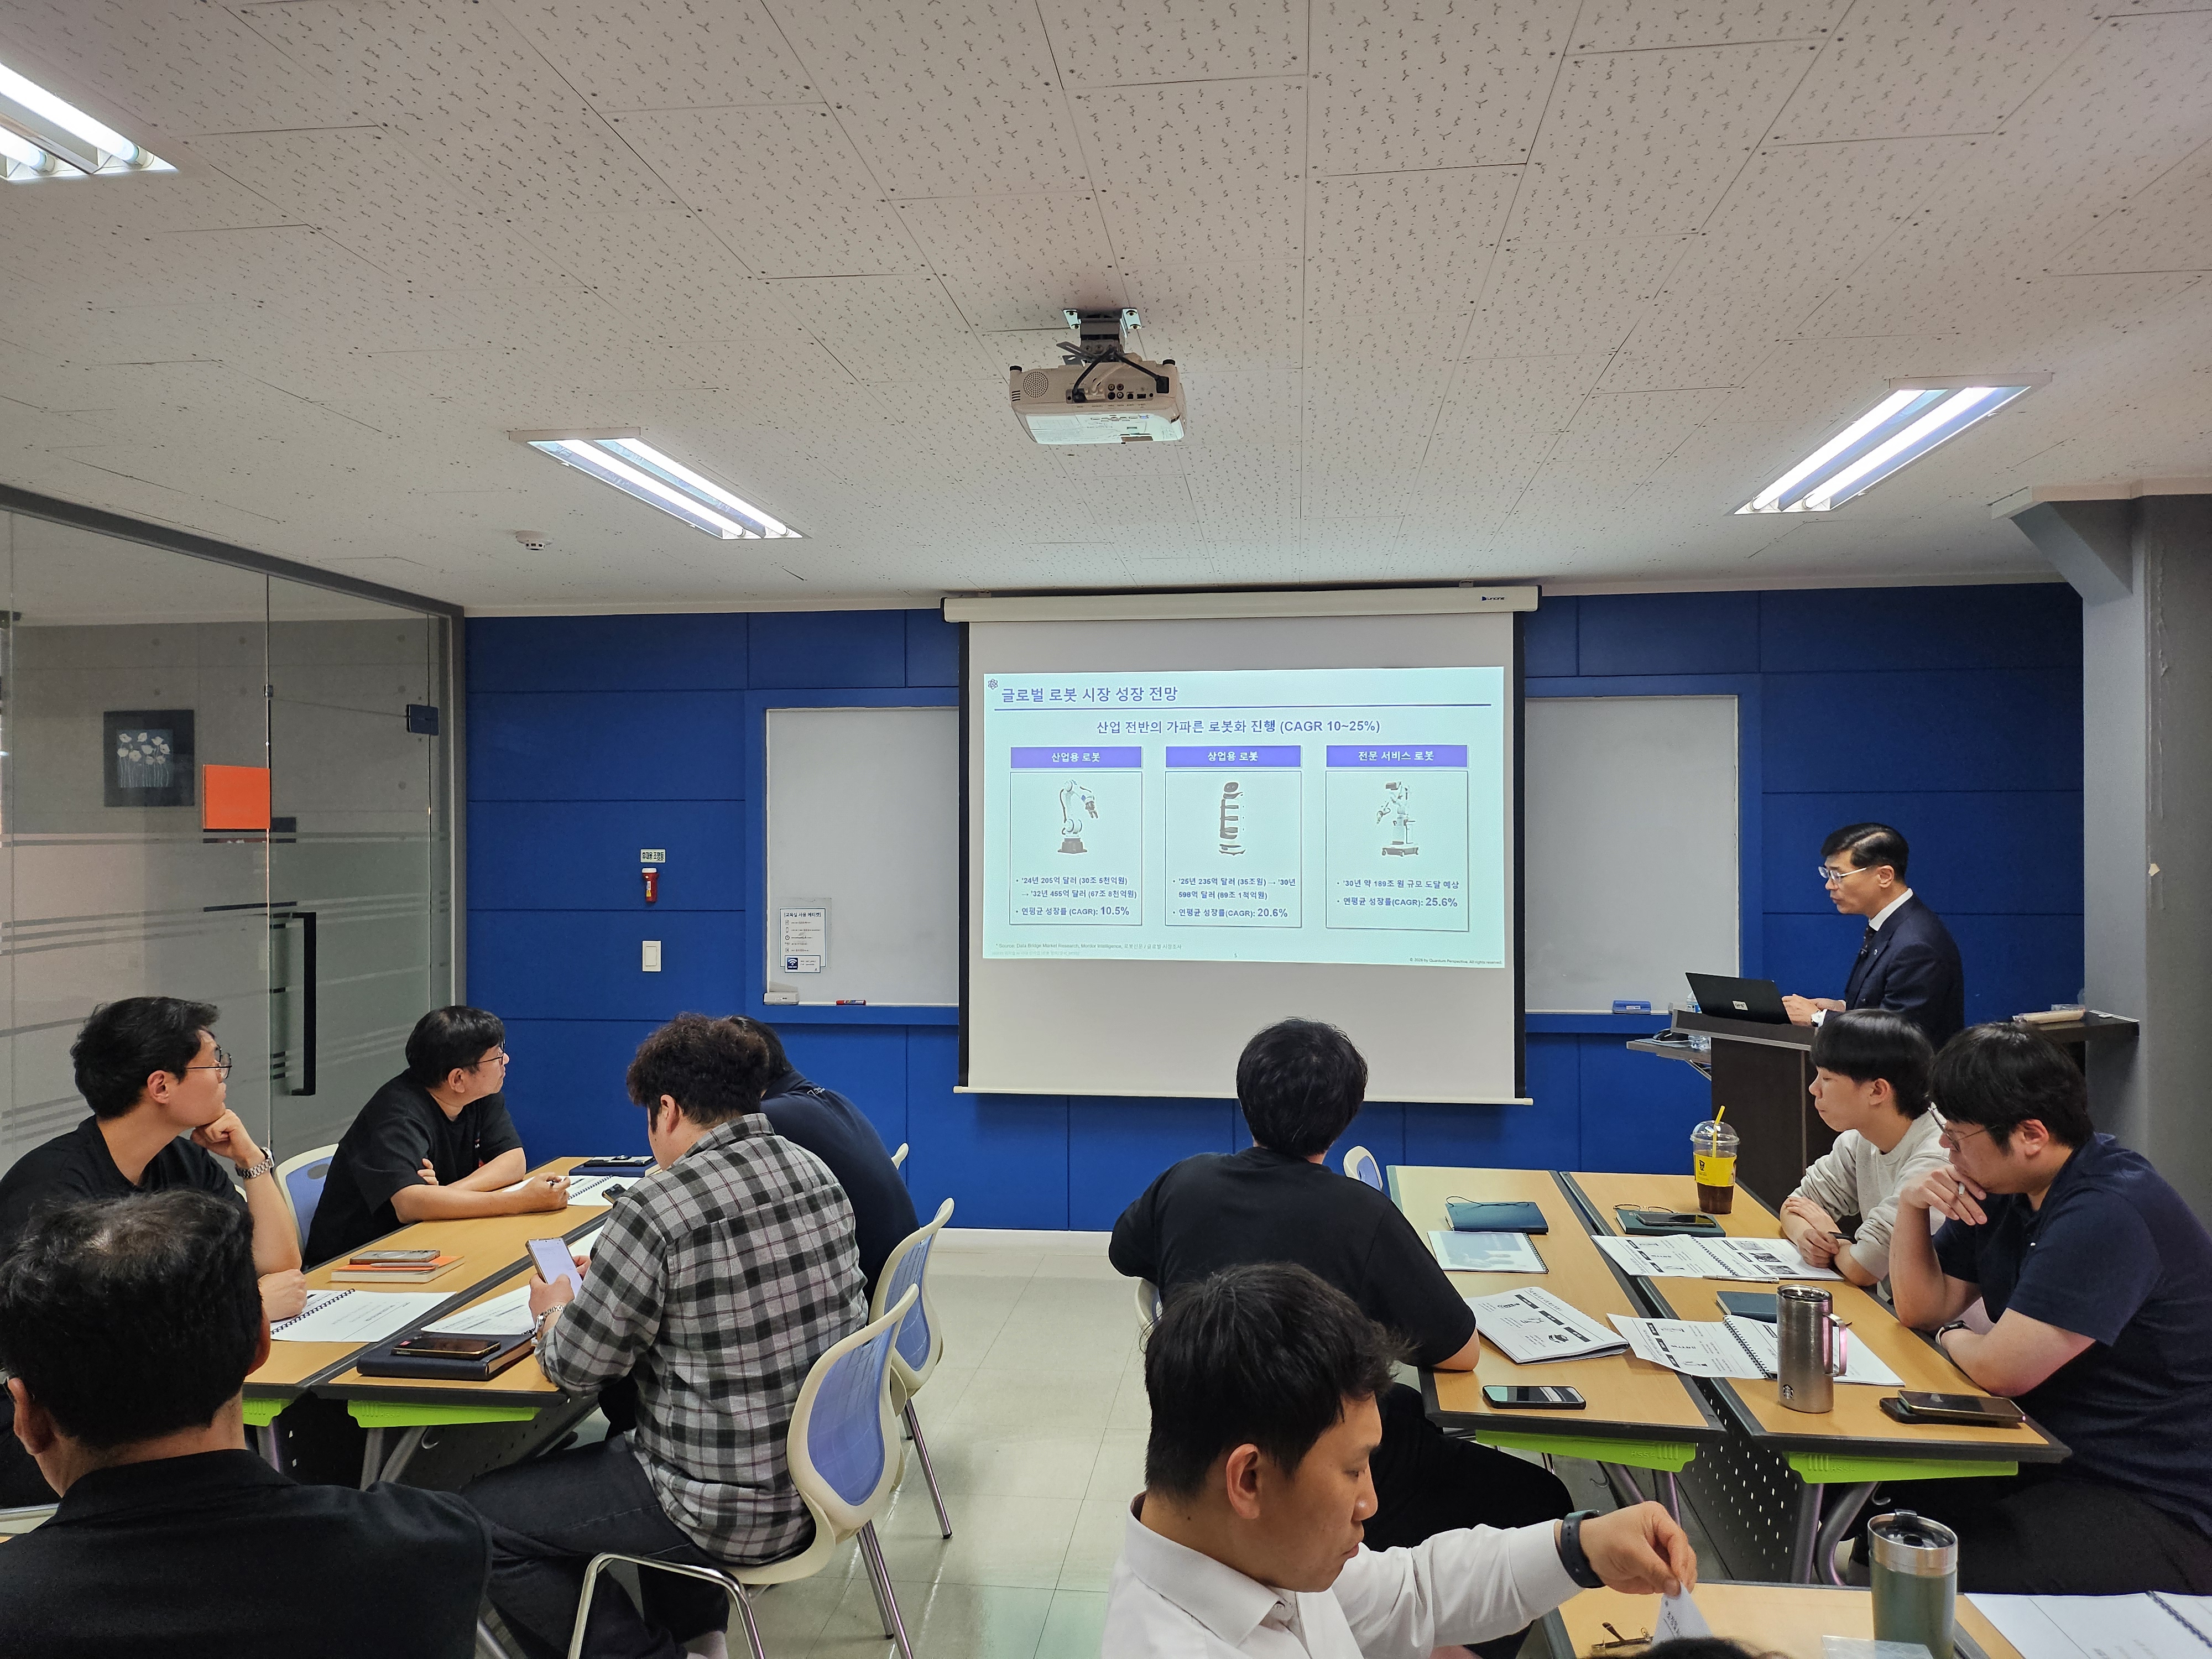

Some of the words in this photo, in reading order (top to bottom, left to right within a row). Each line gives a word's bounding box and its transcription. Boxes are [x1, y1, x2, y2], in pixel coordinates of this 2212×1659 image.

[1001, 688, 1044, 703] 글로벌
[1049, 687, 1077, 702] 로봇
[1082, 687, 1111, 702] 시장
[1115, 687, 1145, 702] 성장
[1149, 686, 1178, 701] 전망
[1097, 721, 1120, 734] 산업
[1125, 721, 1161, 734] 전반의
[1167, 721, 1204, 734] 가파른
[1208, 720, 1247, 733] 로봇화
[1251, 719, 1275, 733] 진행
[1280, 721, 1323, 734] (CAGR
[1327, 721, 1380, 734] 10~25%)
[1051, 752, 1079, 763] 산업용
[1082, 752, 1100, 763] 로봇
[1207, 751, 1237, 761] 상업용
[1239, 751, 1259, 761] 로봇
[1358, 751, 1378, 761] 전문
[1381, 751, 1411, 761] 서비스
[1413, 750, 1434, 761] 로봇
[1041, 876, 1060, 884] 205억
[1062, 876, 1077, 885] 달러
[1079, 877, 1097, 885] (30조
[1099, 877, 1128, 885] 5천억원)
[1198, 878, 1218, 886] 235억
[1220, 877, 1235, 886] 달러
[1238, 878, 1266, 887] (35조원)
[1278, 878, 1296, 886] '30년
[1343, 879, 1361, 888] '30년
[1364, 879, 1371, 888] 약
[1397, 880, 1404, 888] 원
[1407, 880, 1423, 888] 규모
[1425, 880, 1441, 889] 도달
[1443, 881, 1459, 889] 예상
[1050, 889, 1070, 898] 455억
[1072, 889, 1086, 898] 달러
[1088, 890, 1106, 899] (67조
[1108, 890, 1137, 899] 8천억원)
[1201, 890, 1215, 899] 달러
[1217, 891, 1236, 900] (89조
[1343, 897, 1366, 906] 연평균
[1425, 897, 1458, 907] 25.6%
[1021, 907, 1044, 916] 연평균
[1045, 907, 1067, 916] 성장률
[1069, 909, 1098, 917] (CAGR):
[1100, 906, 1129, 916] 10.5%
[1178, 908, 1201, 917] 연평균
[1258, 908, 1288, 917] 20.6%
